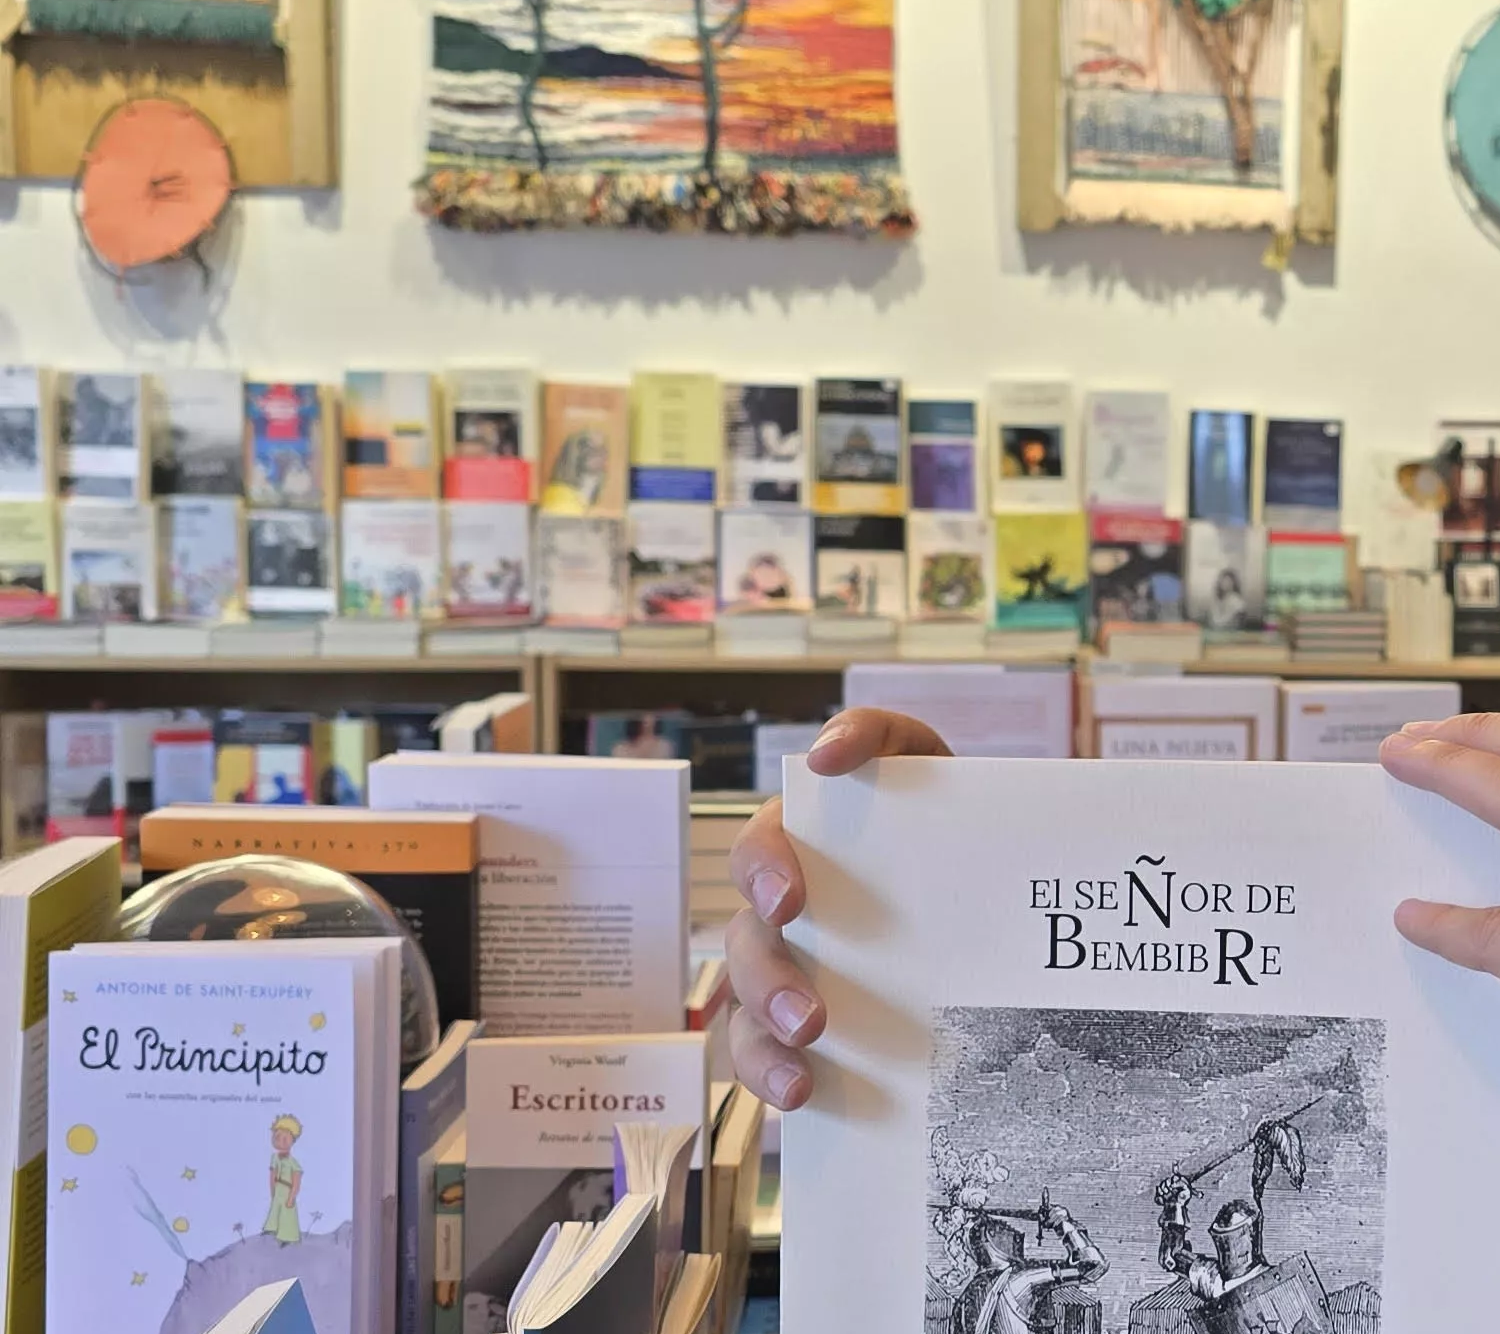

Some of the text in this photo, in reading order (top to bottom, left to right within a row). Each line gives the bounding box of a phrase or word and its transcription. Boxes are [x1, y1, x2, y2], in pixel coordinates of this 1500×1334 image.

[1246, 884, 1296, 915] DE
[1044, 913, 1282, 986] BEMBIBRE
[95, 982, 313, 1000] ANTOINE DE SAINT-EXUPÉRY
[79, 1025, 328, 1086] El Principito
[510, 1085, 666, 1112] Escritoras
